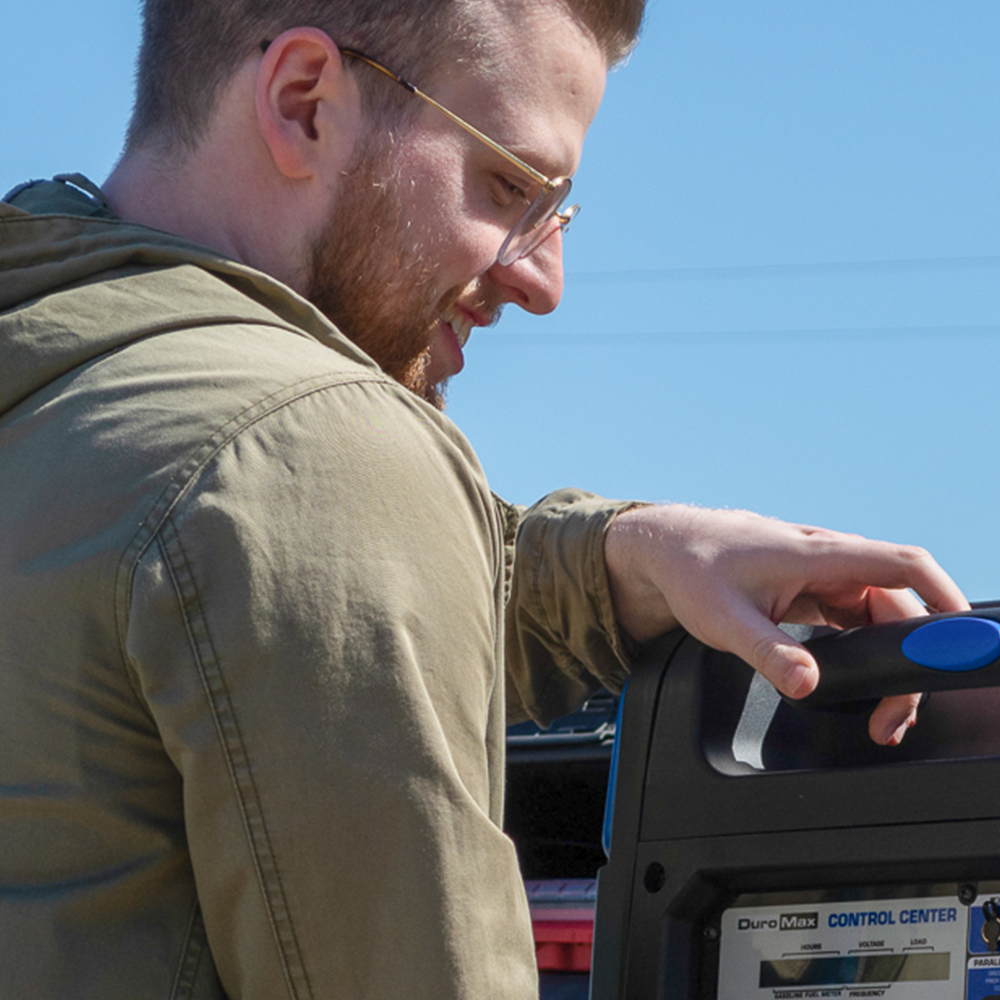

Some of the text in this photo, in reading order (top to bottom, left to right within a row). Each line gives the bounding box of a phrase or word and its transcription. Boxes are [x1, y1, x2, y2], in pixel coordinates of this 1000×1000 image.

[828, 908, 957, 928] CONTROL CENTER
[738, 916, 816, 931] DuroMax
[859, 940, 885, 948] VOLTAGE
[910, 938, 927, 946] LOAD
[801, 943, 822, 951] HOURS
[849, 990, 885, 998] FREQUENCY
